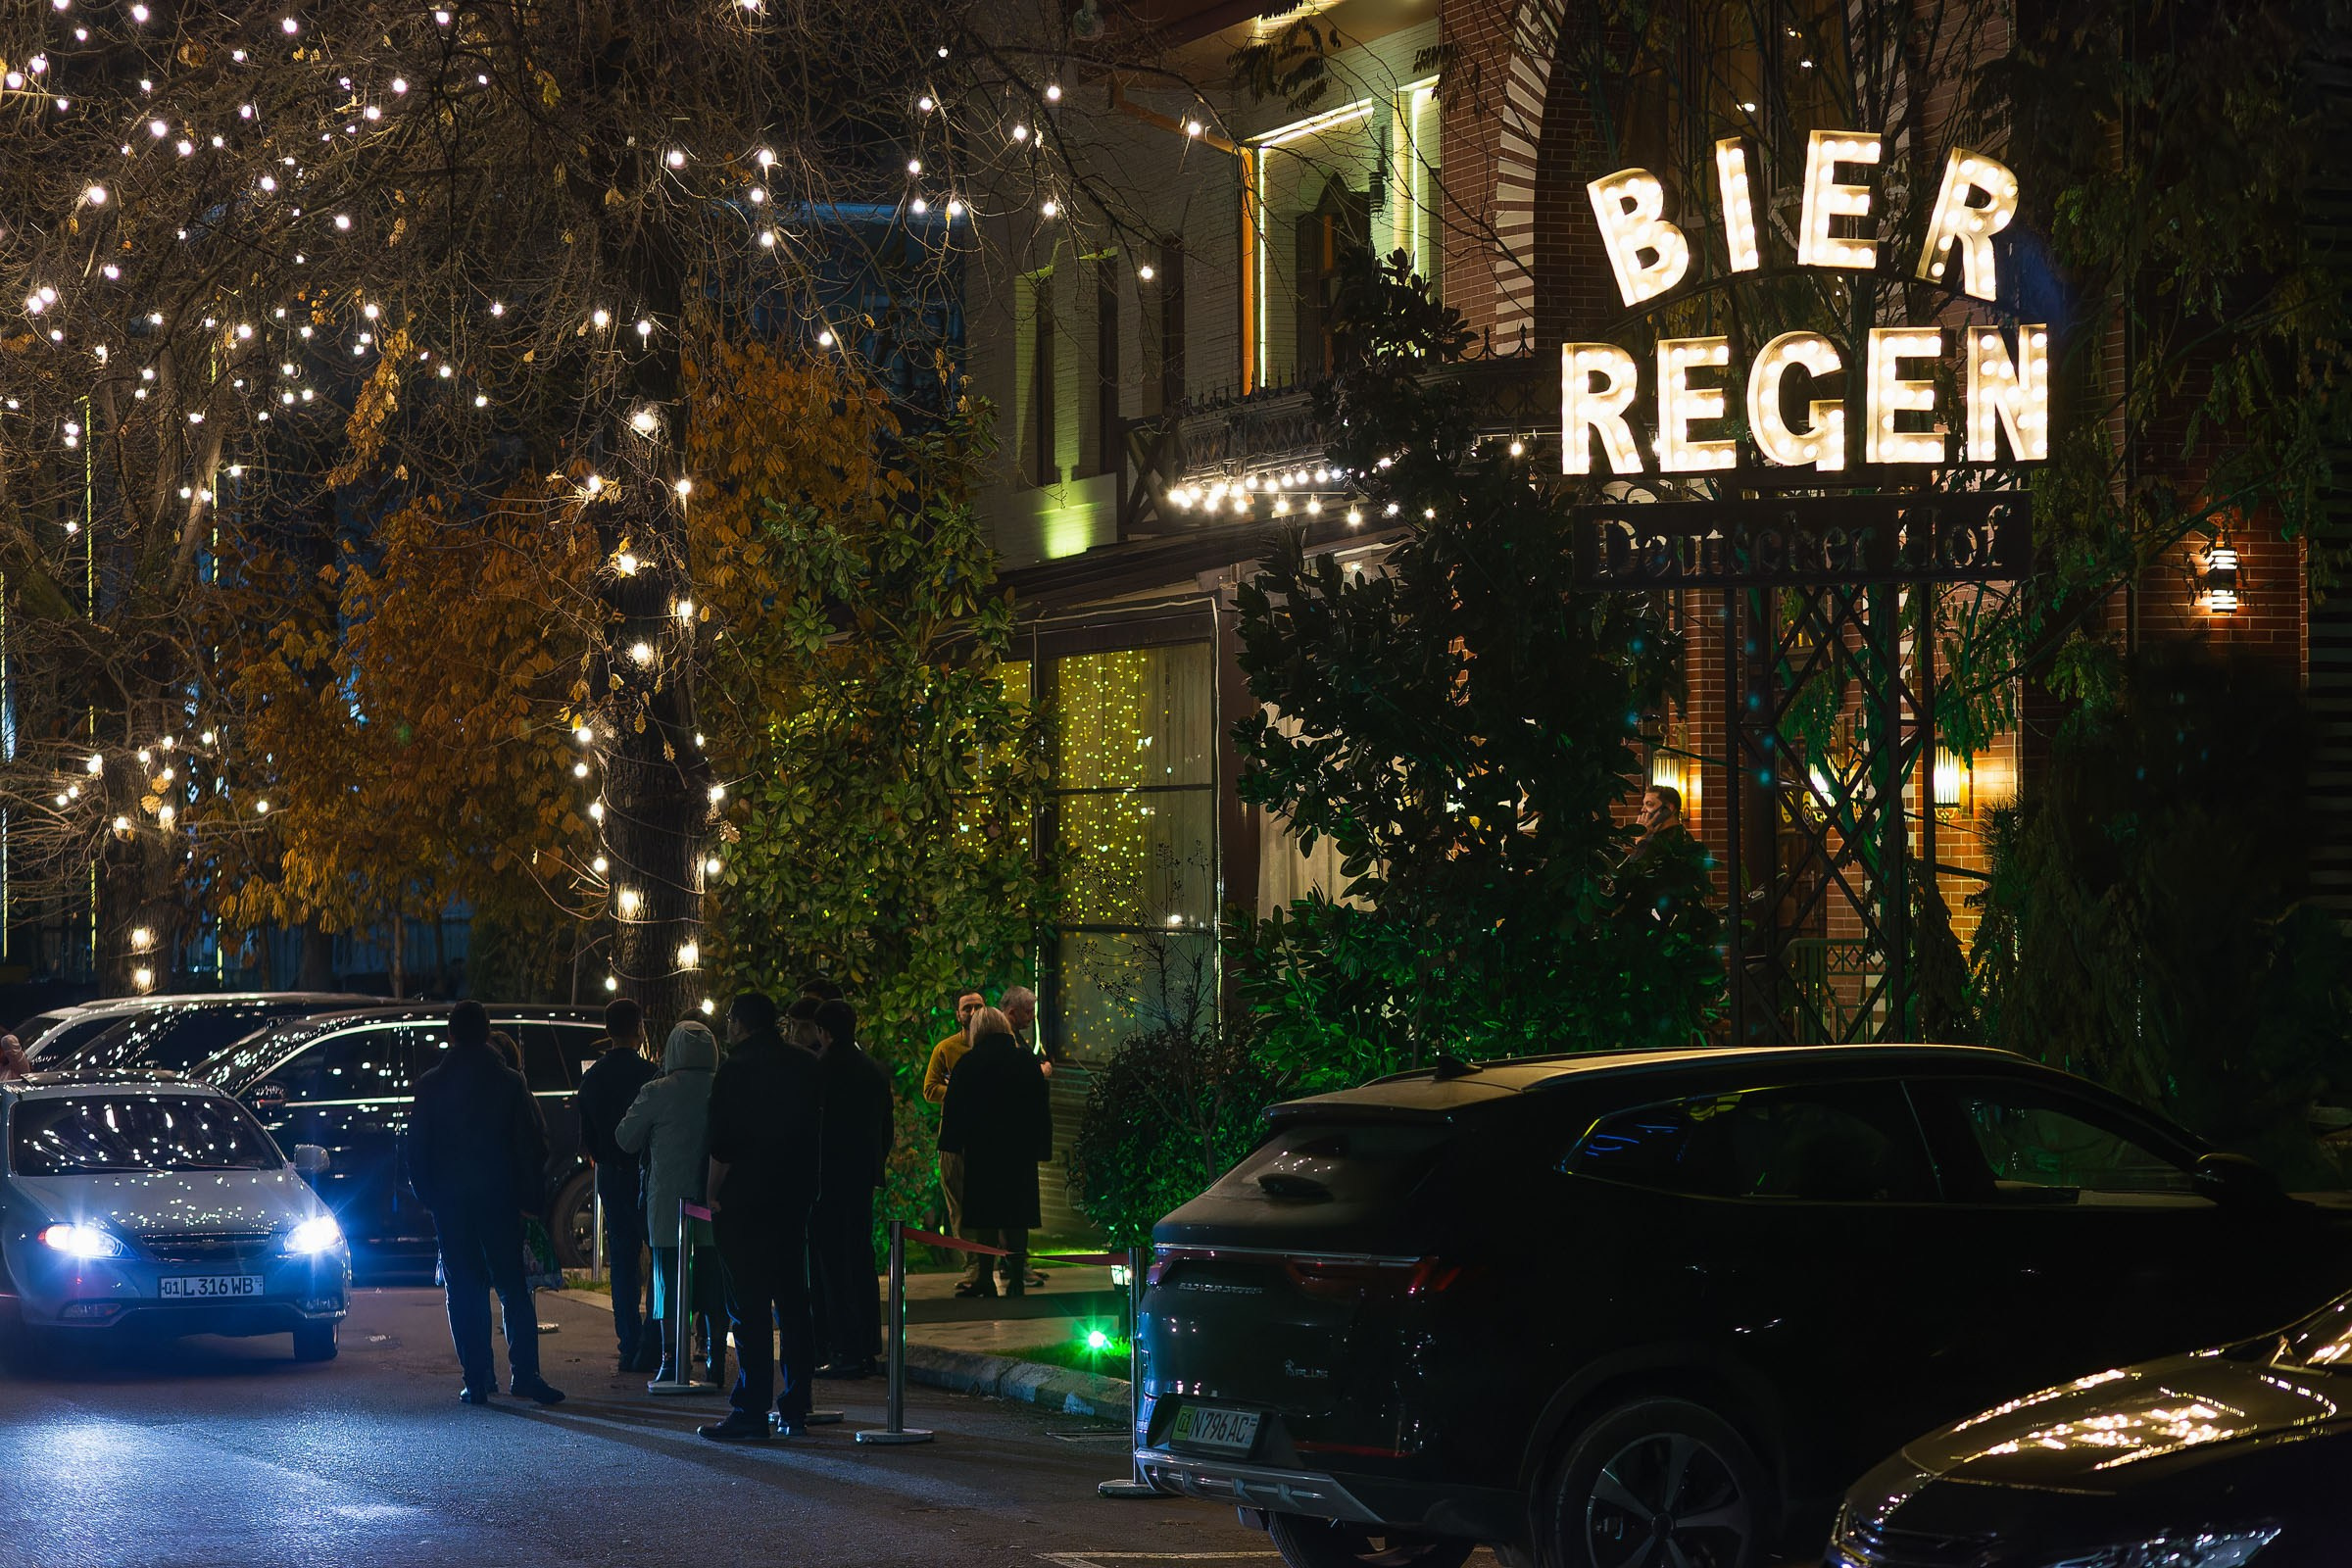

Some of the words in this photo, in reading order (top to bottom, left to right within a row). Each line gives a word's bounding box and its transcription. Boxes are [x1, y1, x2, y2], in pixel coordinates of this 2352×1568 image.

[1587, 129, 2019, 308] BIER
[1562, 323, 2048, 475] REGEN
[1592, 510, 1876, 579] Deutscher
[1893, 503, 2012, 570] Hof
